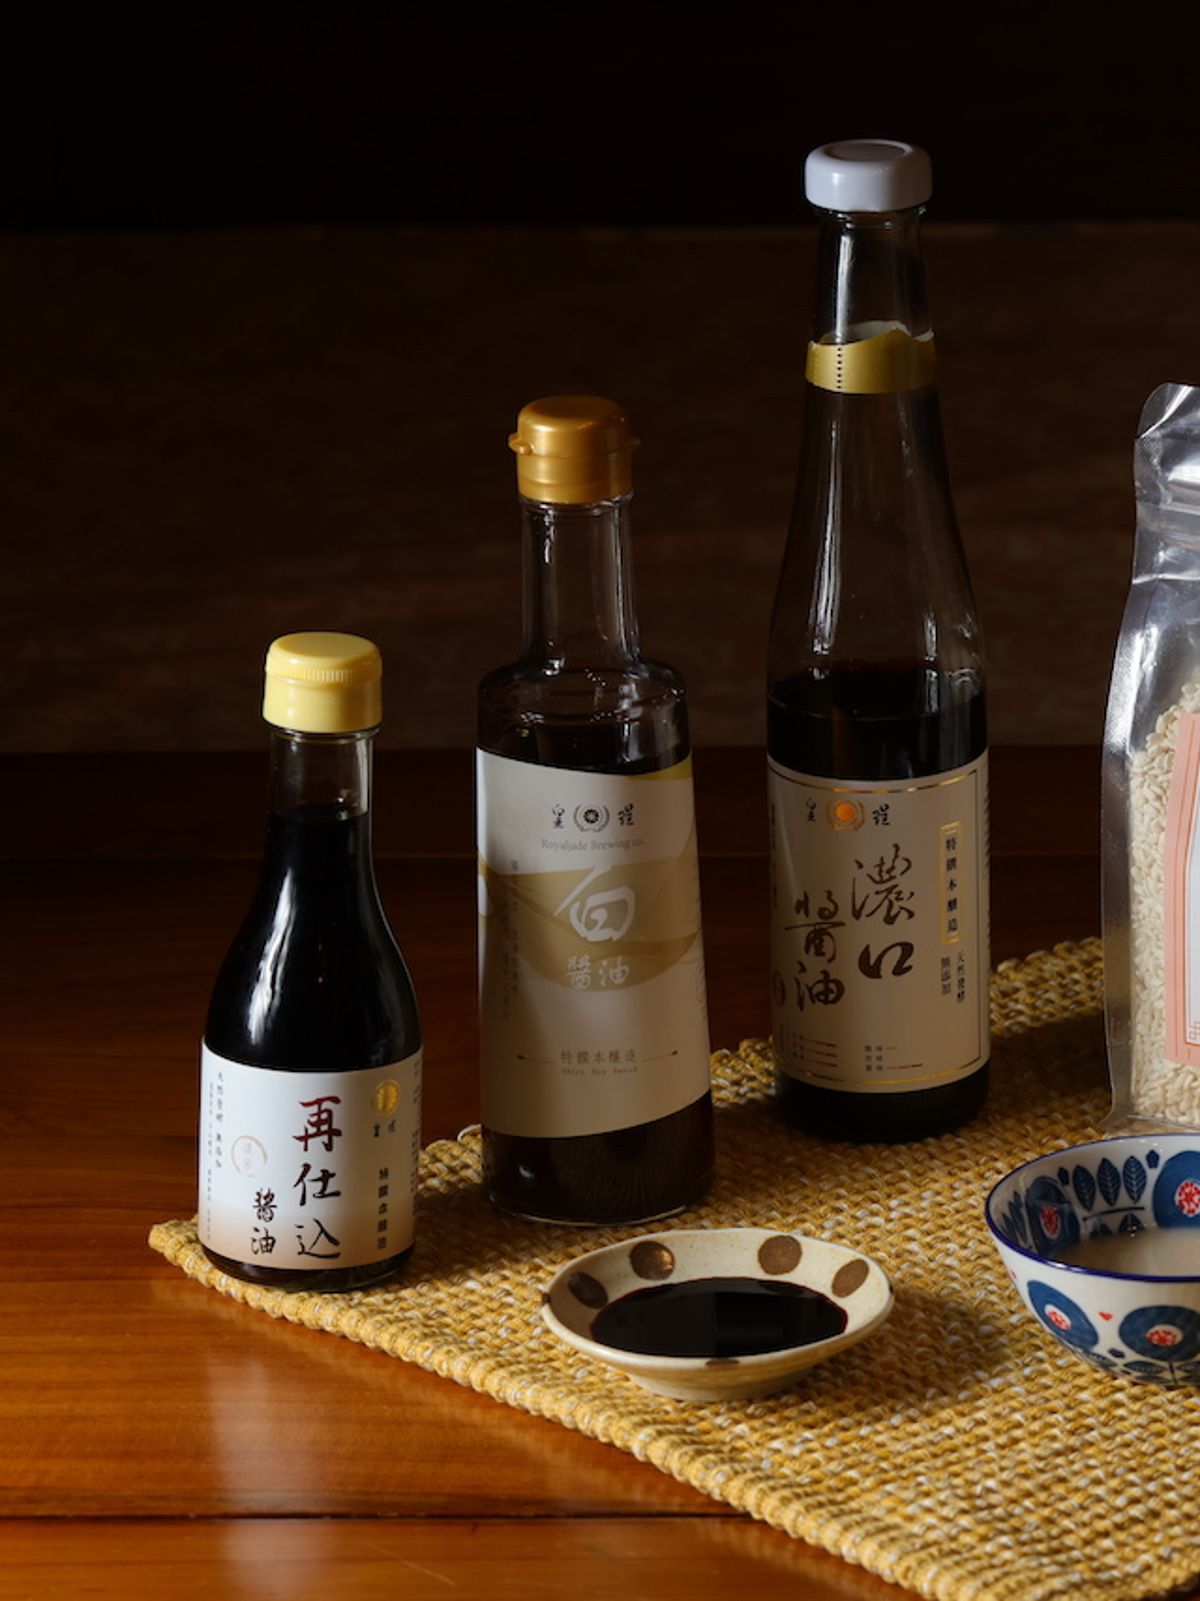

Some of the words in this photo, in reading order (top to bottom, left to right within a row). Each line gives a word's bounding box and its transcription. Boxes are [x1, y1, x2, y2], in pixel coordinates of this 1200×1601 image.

[567, 953, 630, 990] 醬油
[292, 1095, 342, 1259] 再仕込
[251, 1186, 278, 1255] 醬油
